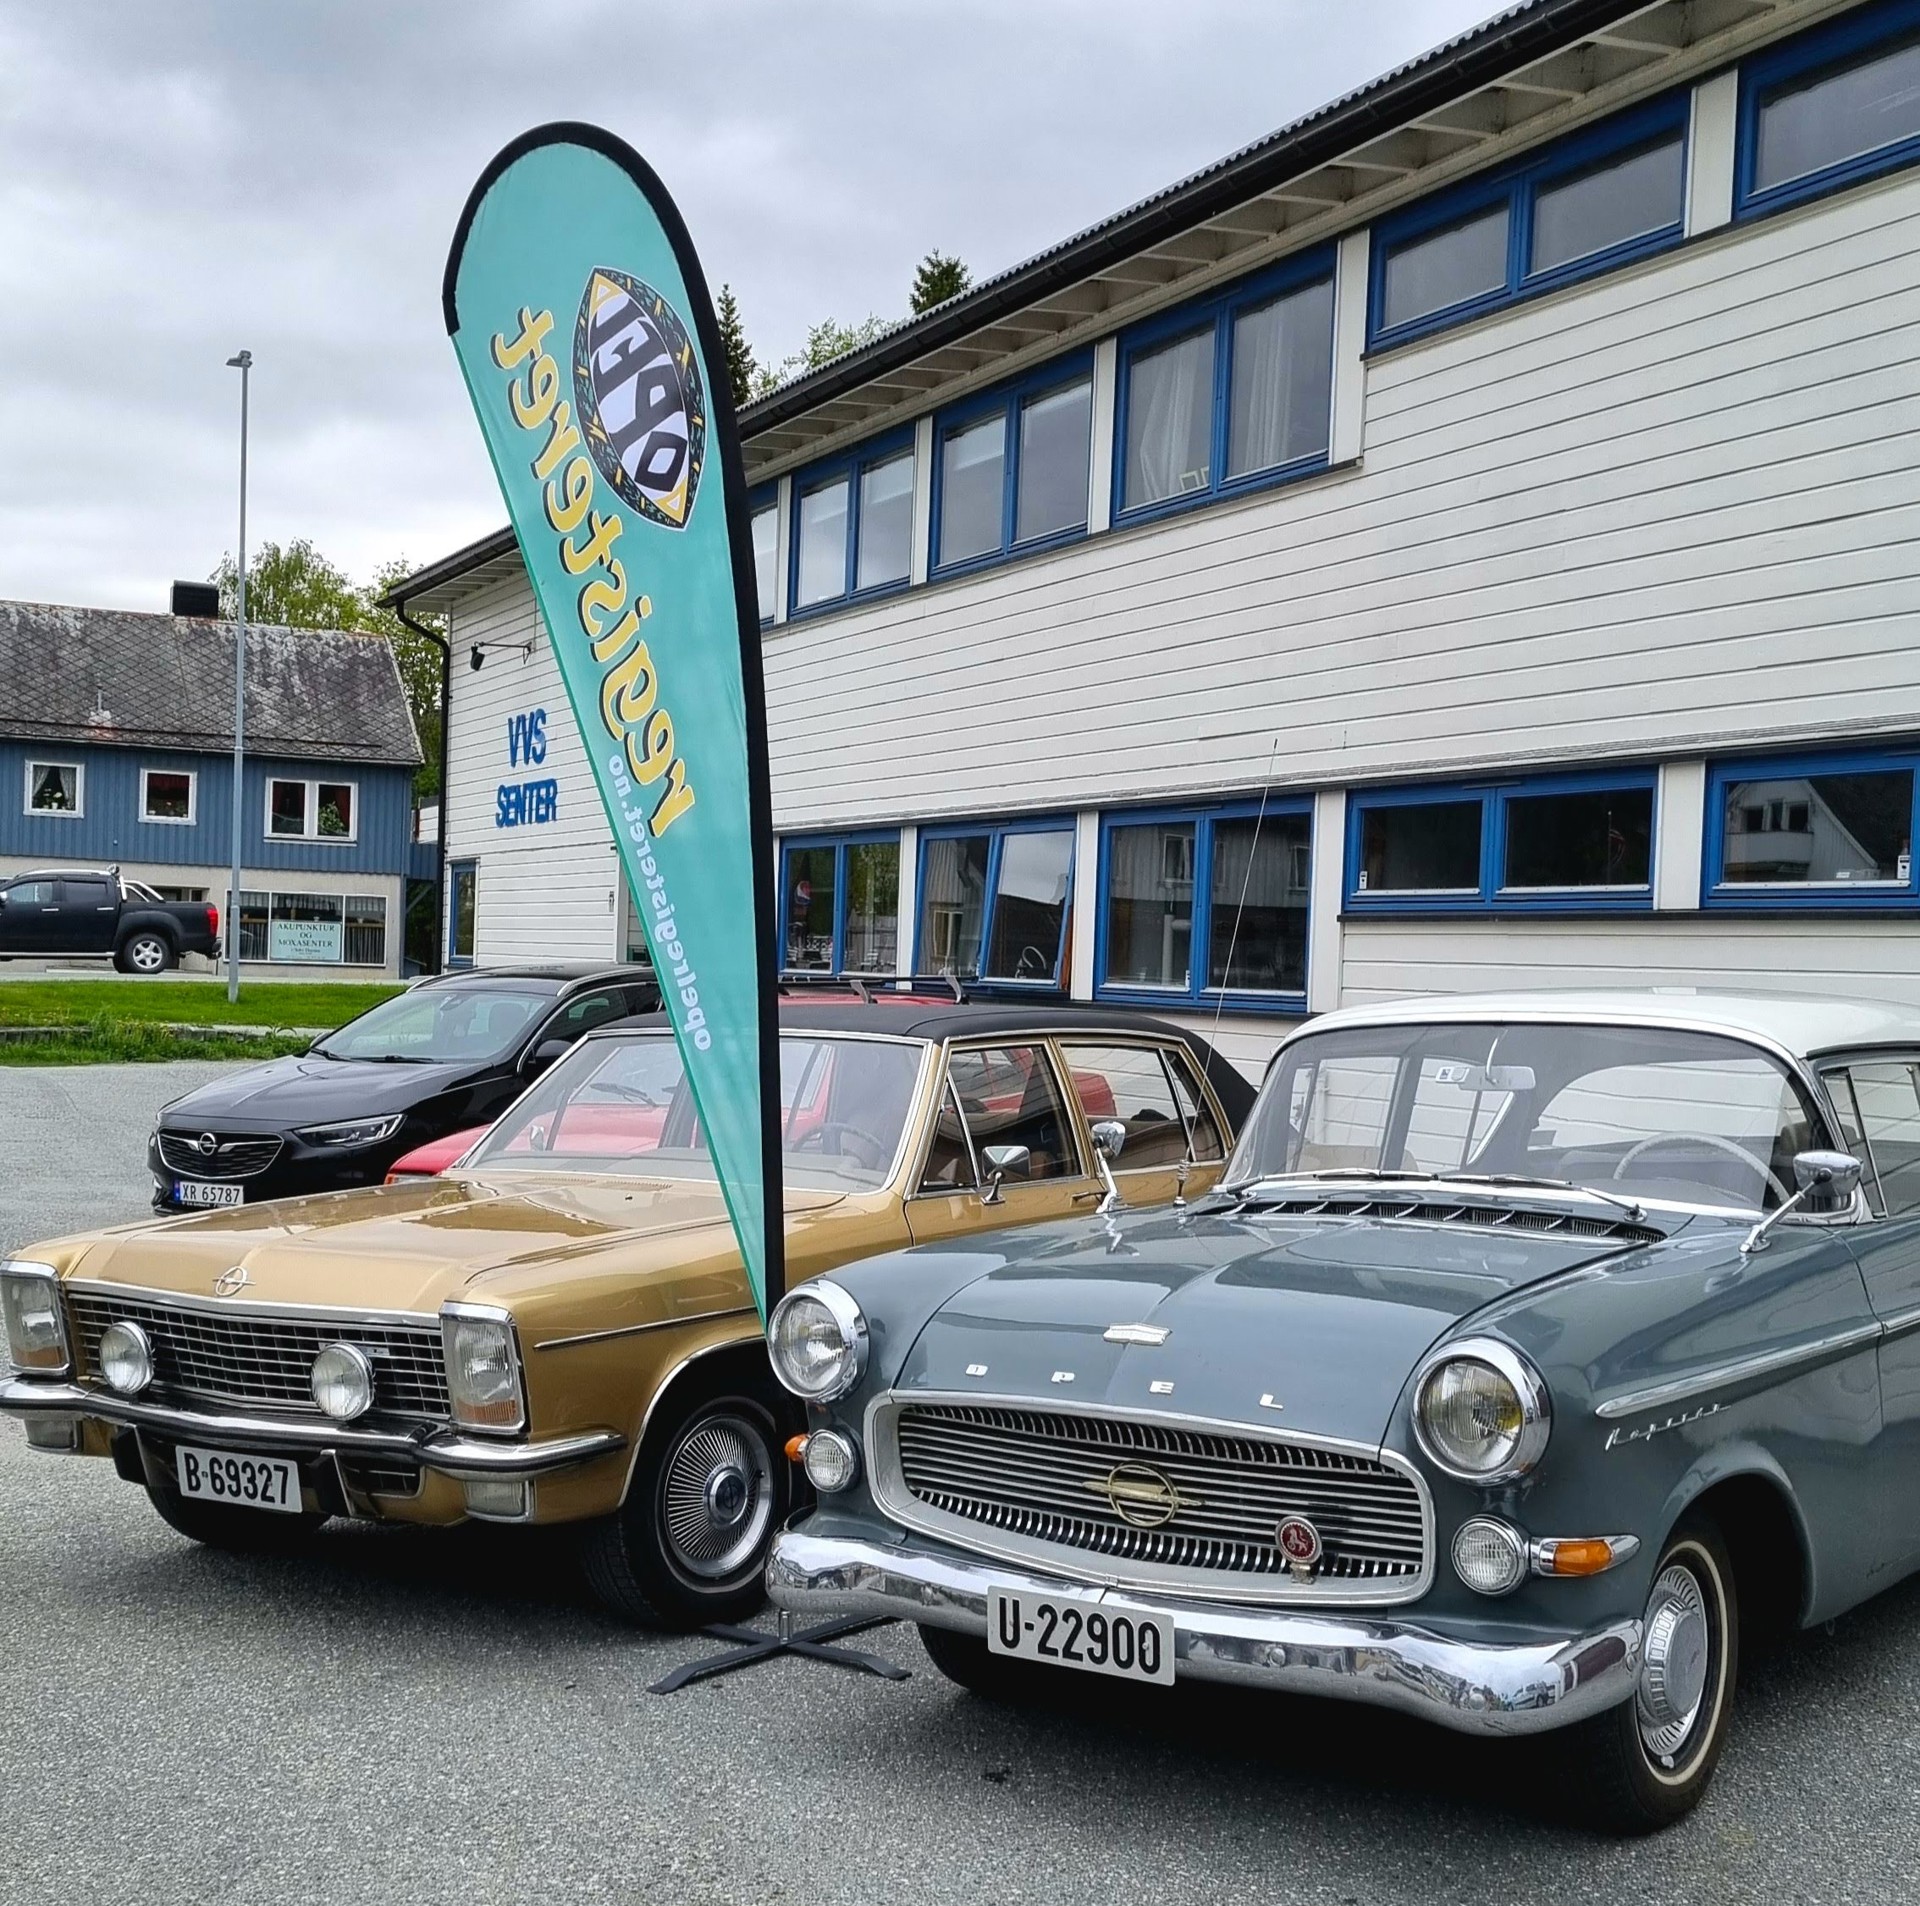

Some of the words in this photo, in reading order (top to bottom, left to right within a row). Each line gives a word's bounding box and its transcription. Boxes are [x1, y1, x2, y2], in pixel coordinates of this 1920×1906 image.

[507, 708, 547, 768] VVS
[495, 778, 558, 828] SENTER
[277, 923, 335, 932] AKUPUNKTUR
[278, 939, 333, 947] MOXASENTER
[182, 1183, 197, 1201] XR
[201, 1186, 241, 1203] 65787
[999, 1597, 1161, 1675] U-22900
